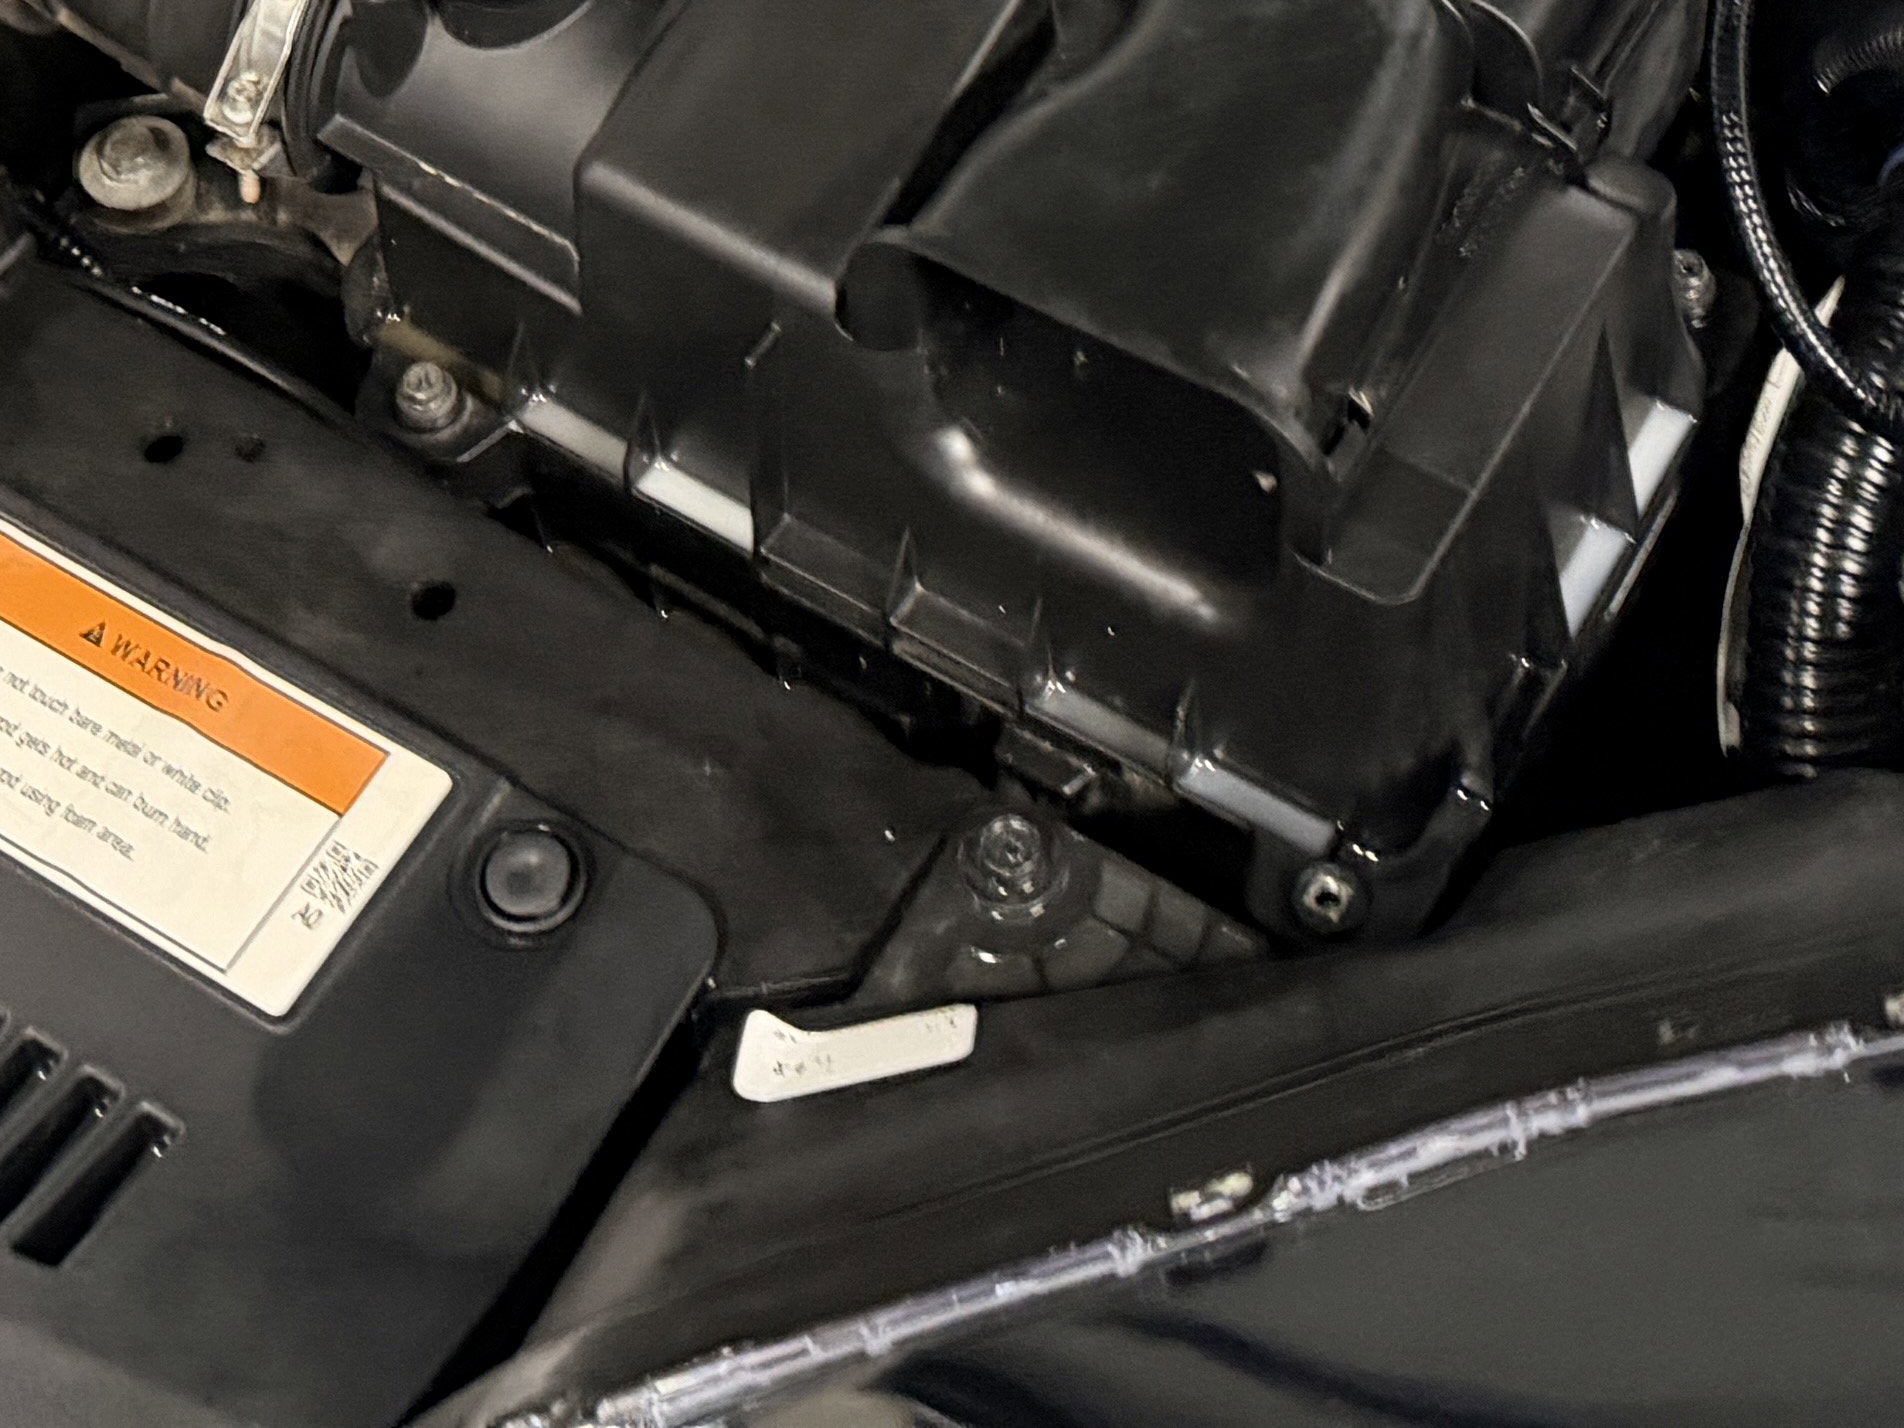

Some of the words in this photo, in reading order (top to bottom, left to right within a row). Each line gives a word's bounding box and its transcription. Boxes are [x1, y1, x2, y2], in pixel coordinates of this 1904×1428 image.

[3, 669, 30, 693] not
[110, 632, 230, 713] WARNING
[51, 745, 79, 773] hot
